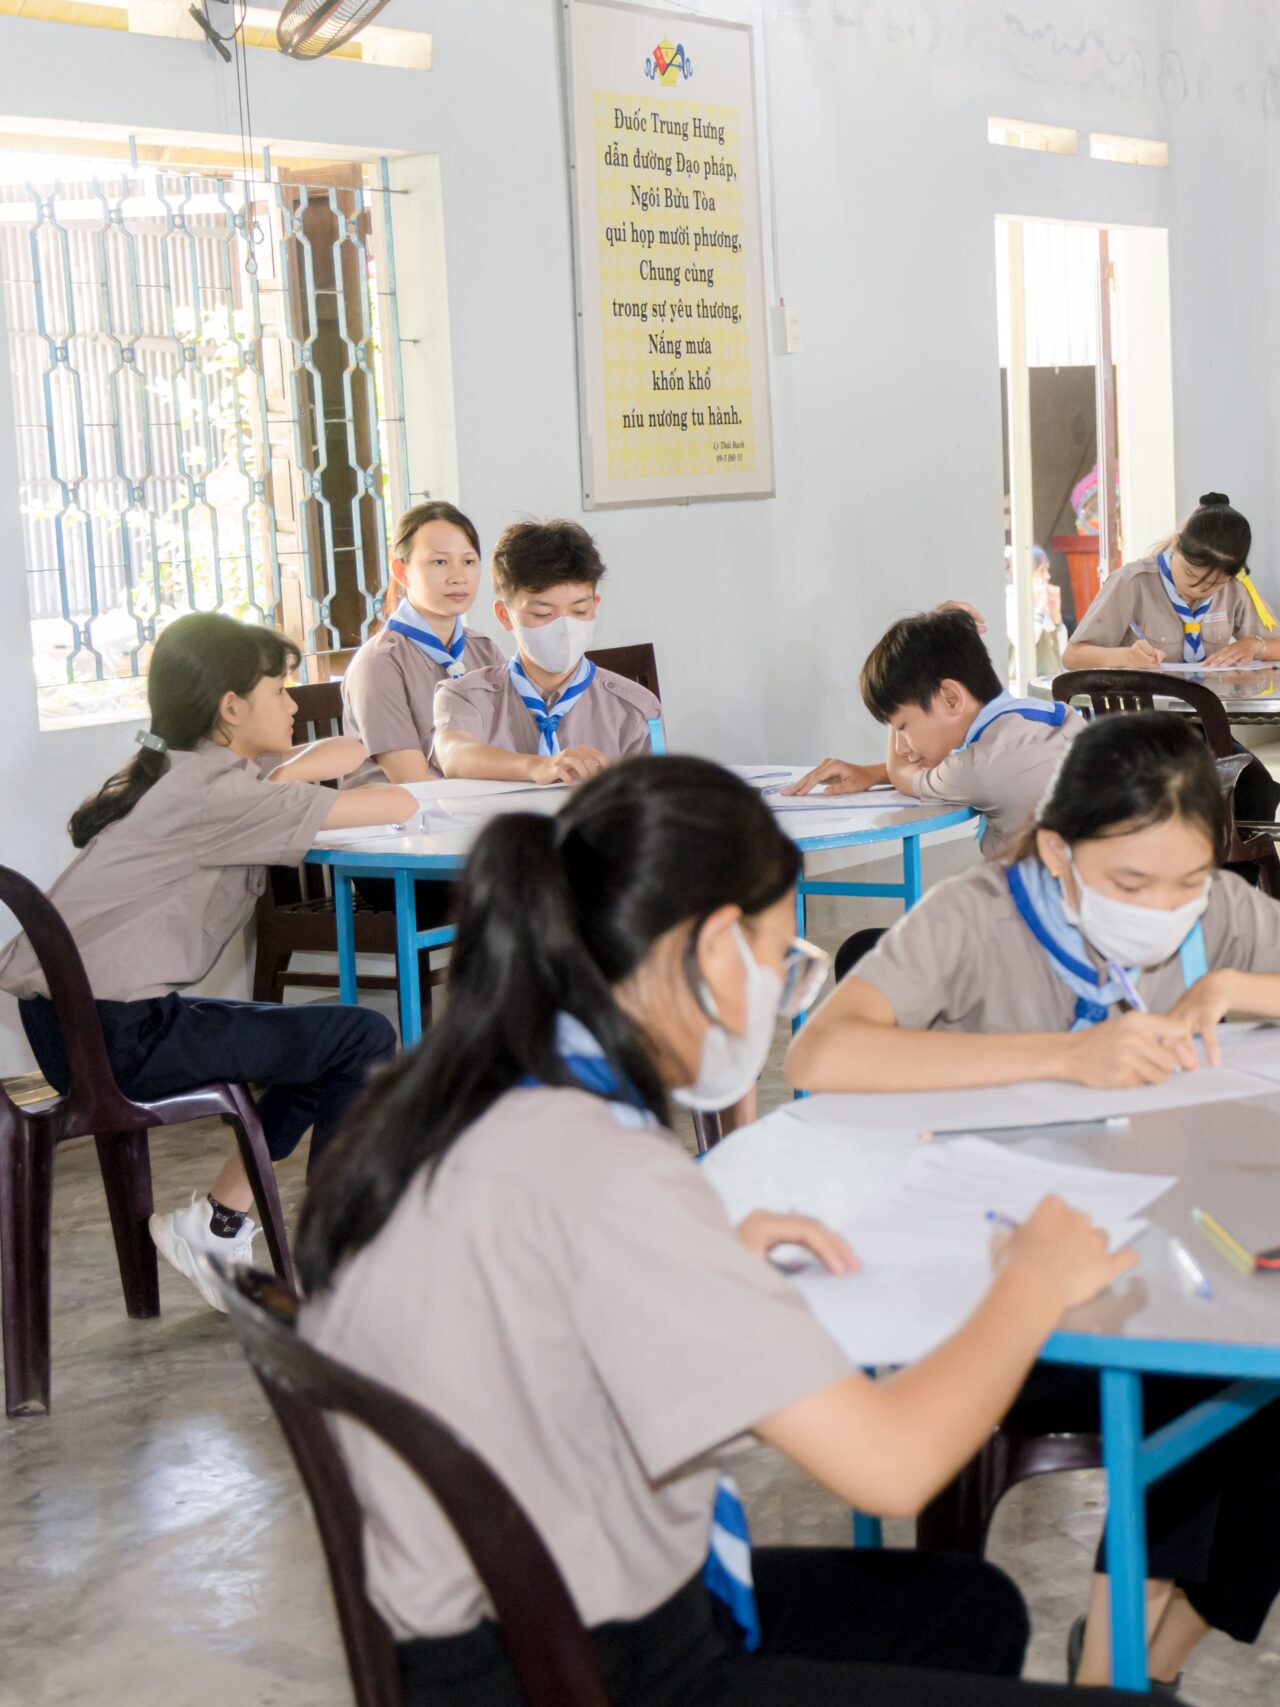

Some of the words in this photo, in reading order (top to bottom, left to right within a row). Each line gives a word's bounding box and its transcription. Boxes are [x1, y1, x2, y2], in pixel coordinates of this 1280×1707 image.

[614, 107, 647, 132] Đuốc
[651, 112, 689, 141] Trung
[692, 117, 725, 145] Hưng
[604, 141, 629, 167] dẫn
[633, 148, 672, 176] đường
[676, 152, 700, 178] Đạo
[704, 155, 737, 182] pháp,
[630, 185, 660, 211] Ngôi
[664, 187, 690, 209] Bửu
[693, 190, 716, 211] Tòa
[605, 221, 627, 247] qui
[630, 222, 655, 248] họp
[659, 225, 690, 246] mười
[694, 226, 742, 253] phương,
[639, 259, 681, 286] Chung
[685, 262, 714, 287] cùng
[612, 298, 648, 322] trong
[652, 300, 667, 322] sự
[670, 299, 692, 323] yêu
[697, 298, 742, 324] thương,
[648, 330, 682, 359] Nắng
[685, 337, 712, 354] mưa
[652, 368, 684, 391] khốn
[688, 366, 711, 390] khổ
[622, 408, 644, 428] níu
[648, 409, 688, 431] nương
[692, 408, 704, 426] tu
[708, 405, 742, 425] hành.
